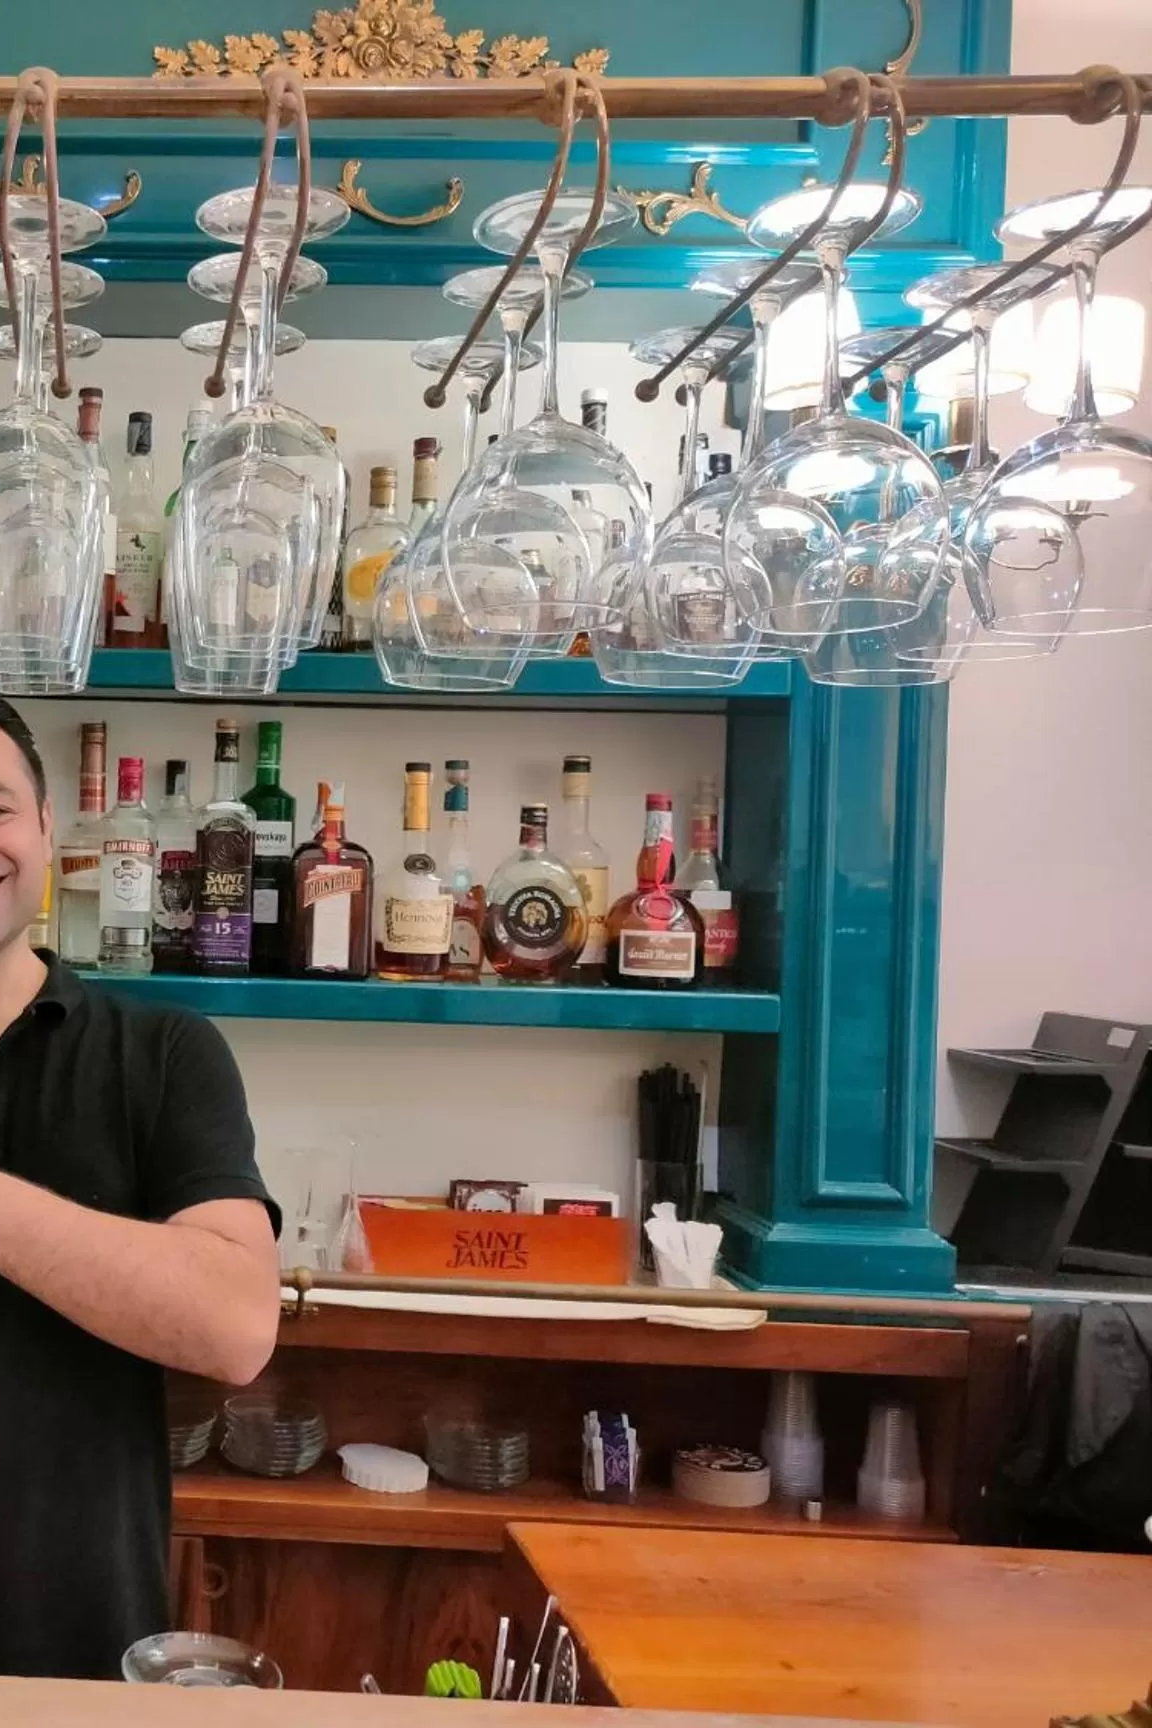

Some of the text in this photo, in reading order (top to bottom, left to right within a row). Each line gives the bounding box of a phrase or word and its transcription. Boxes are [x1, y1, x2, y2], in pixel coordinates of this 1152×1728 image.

[105, 840, 152, 853] SMIRNOFF
[205, 871, 246, 884] SAINT
[200, 882, 247, 896] JAMES
[215, 921, 232, 935] 15
[452, 1230, 529, 1250] SAINT
[446, 1245, 530, 1269] JAMES
